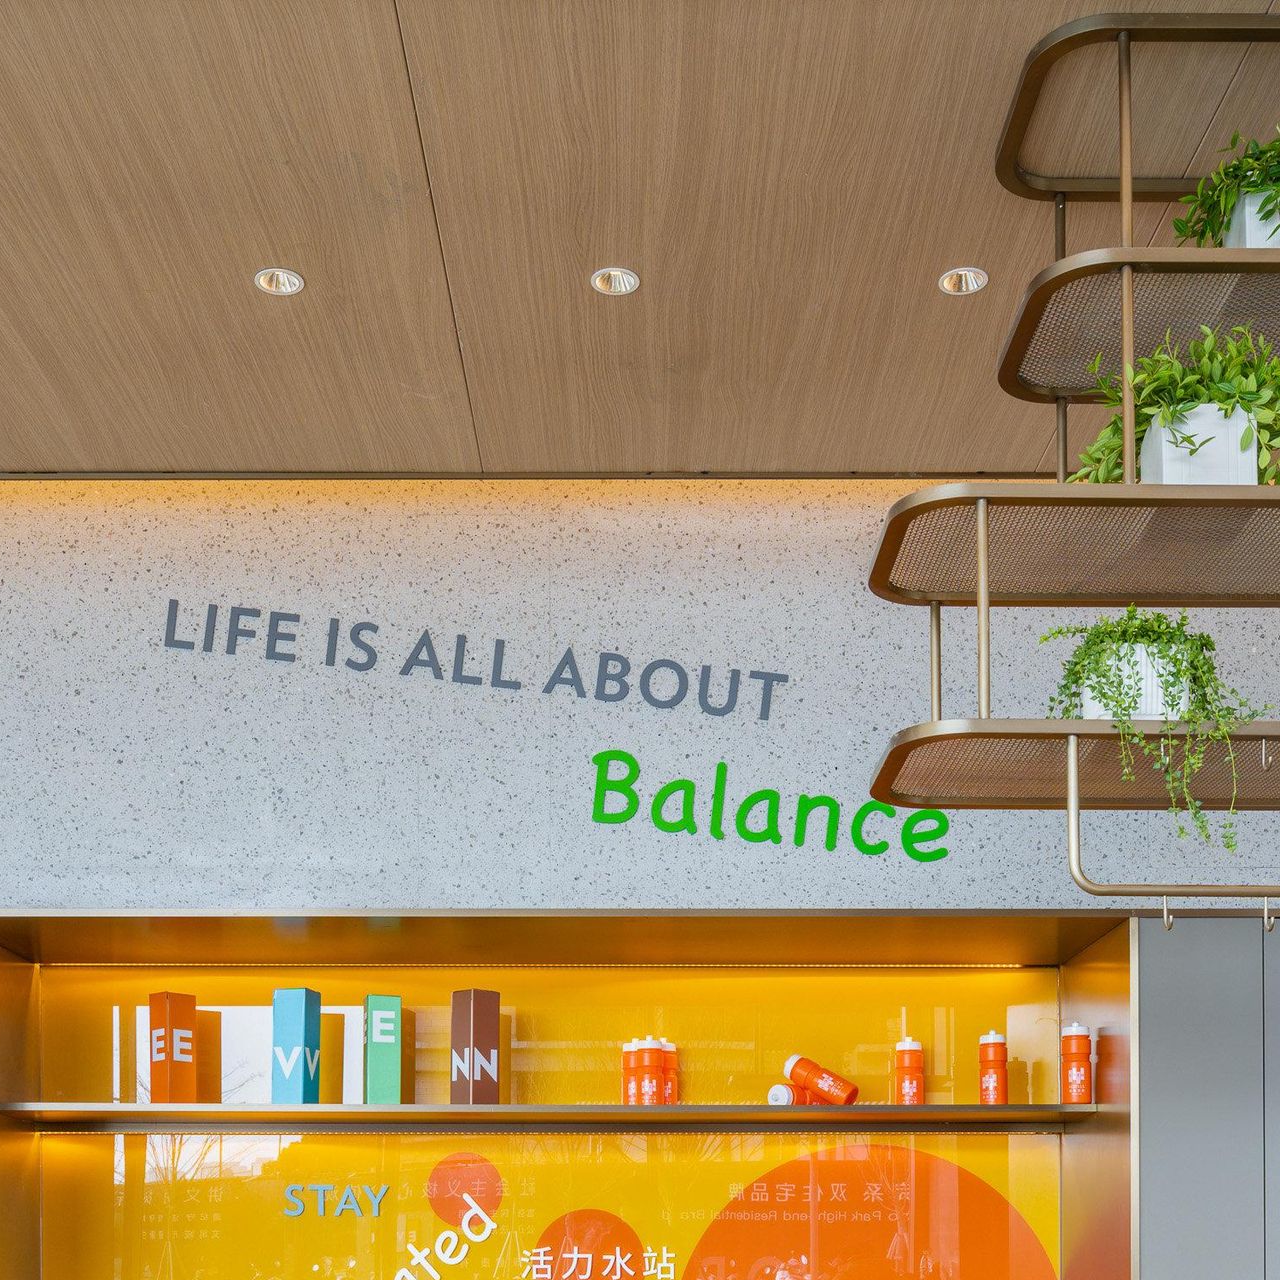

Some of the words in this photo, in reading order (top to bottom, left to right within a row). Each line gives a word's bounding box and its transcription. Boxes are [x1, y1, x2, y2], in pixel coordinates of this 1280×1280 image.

[163, 598, 301, 663] LIFE
[324, 617, 380, 673] IS
[399, 628, 522, 692] ALL
[541, 646, 790, 721] ABOUT
[591, 749, 950, 863] Balance
[284, 1184, 388, 1218] STAY
[520, 1245, 676, 1280] 活力水站
